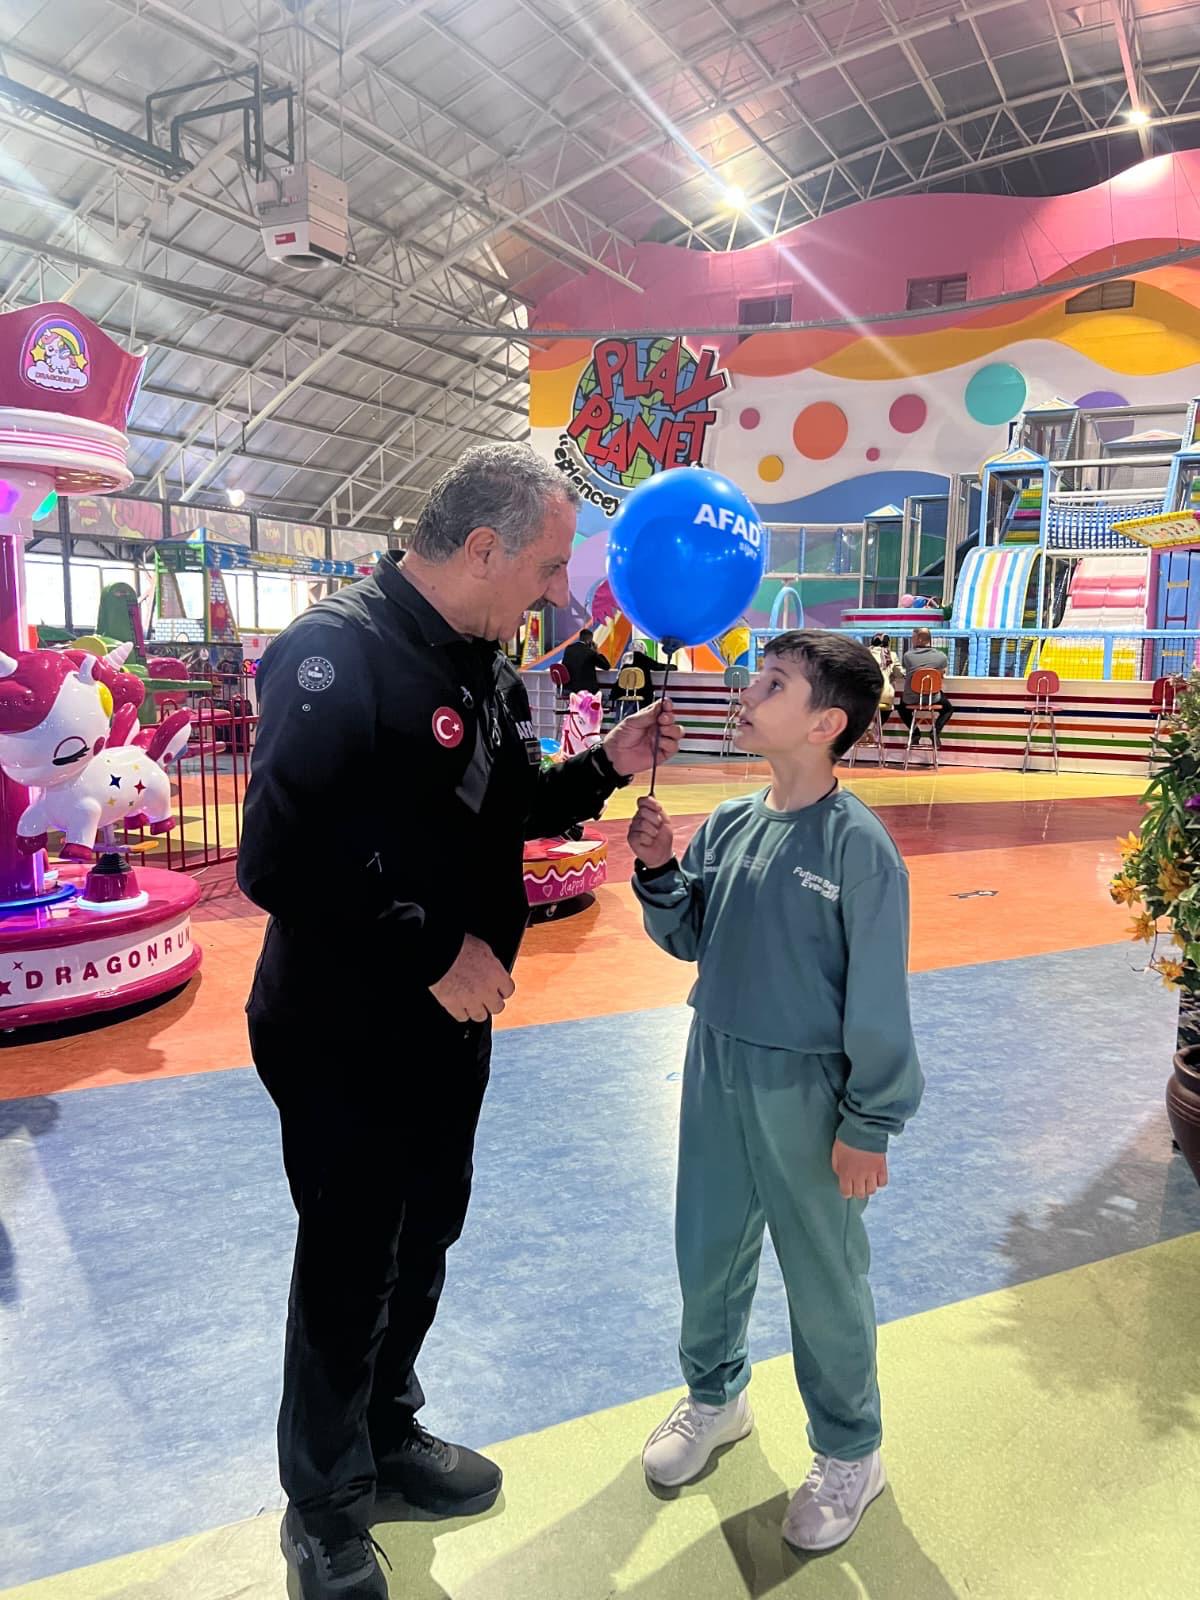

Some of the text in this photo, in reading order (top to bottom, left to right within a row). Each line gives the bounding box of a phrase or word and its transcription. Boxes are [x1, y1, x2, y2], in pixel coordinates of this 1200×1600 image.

[594, 337, 728, 412] PLAY
[567, 392, 716, 473] PLANET
[693, 503, 761, 548] AFAD
[792, 866, 823, 884] Future
[25, 926, 190, 990] DRAGONRUN
